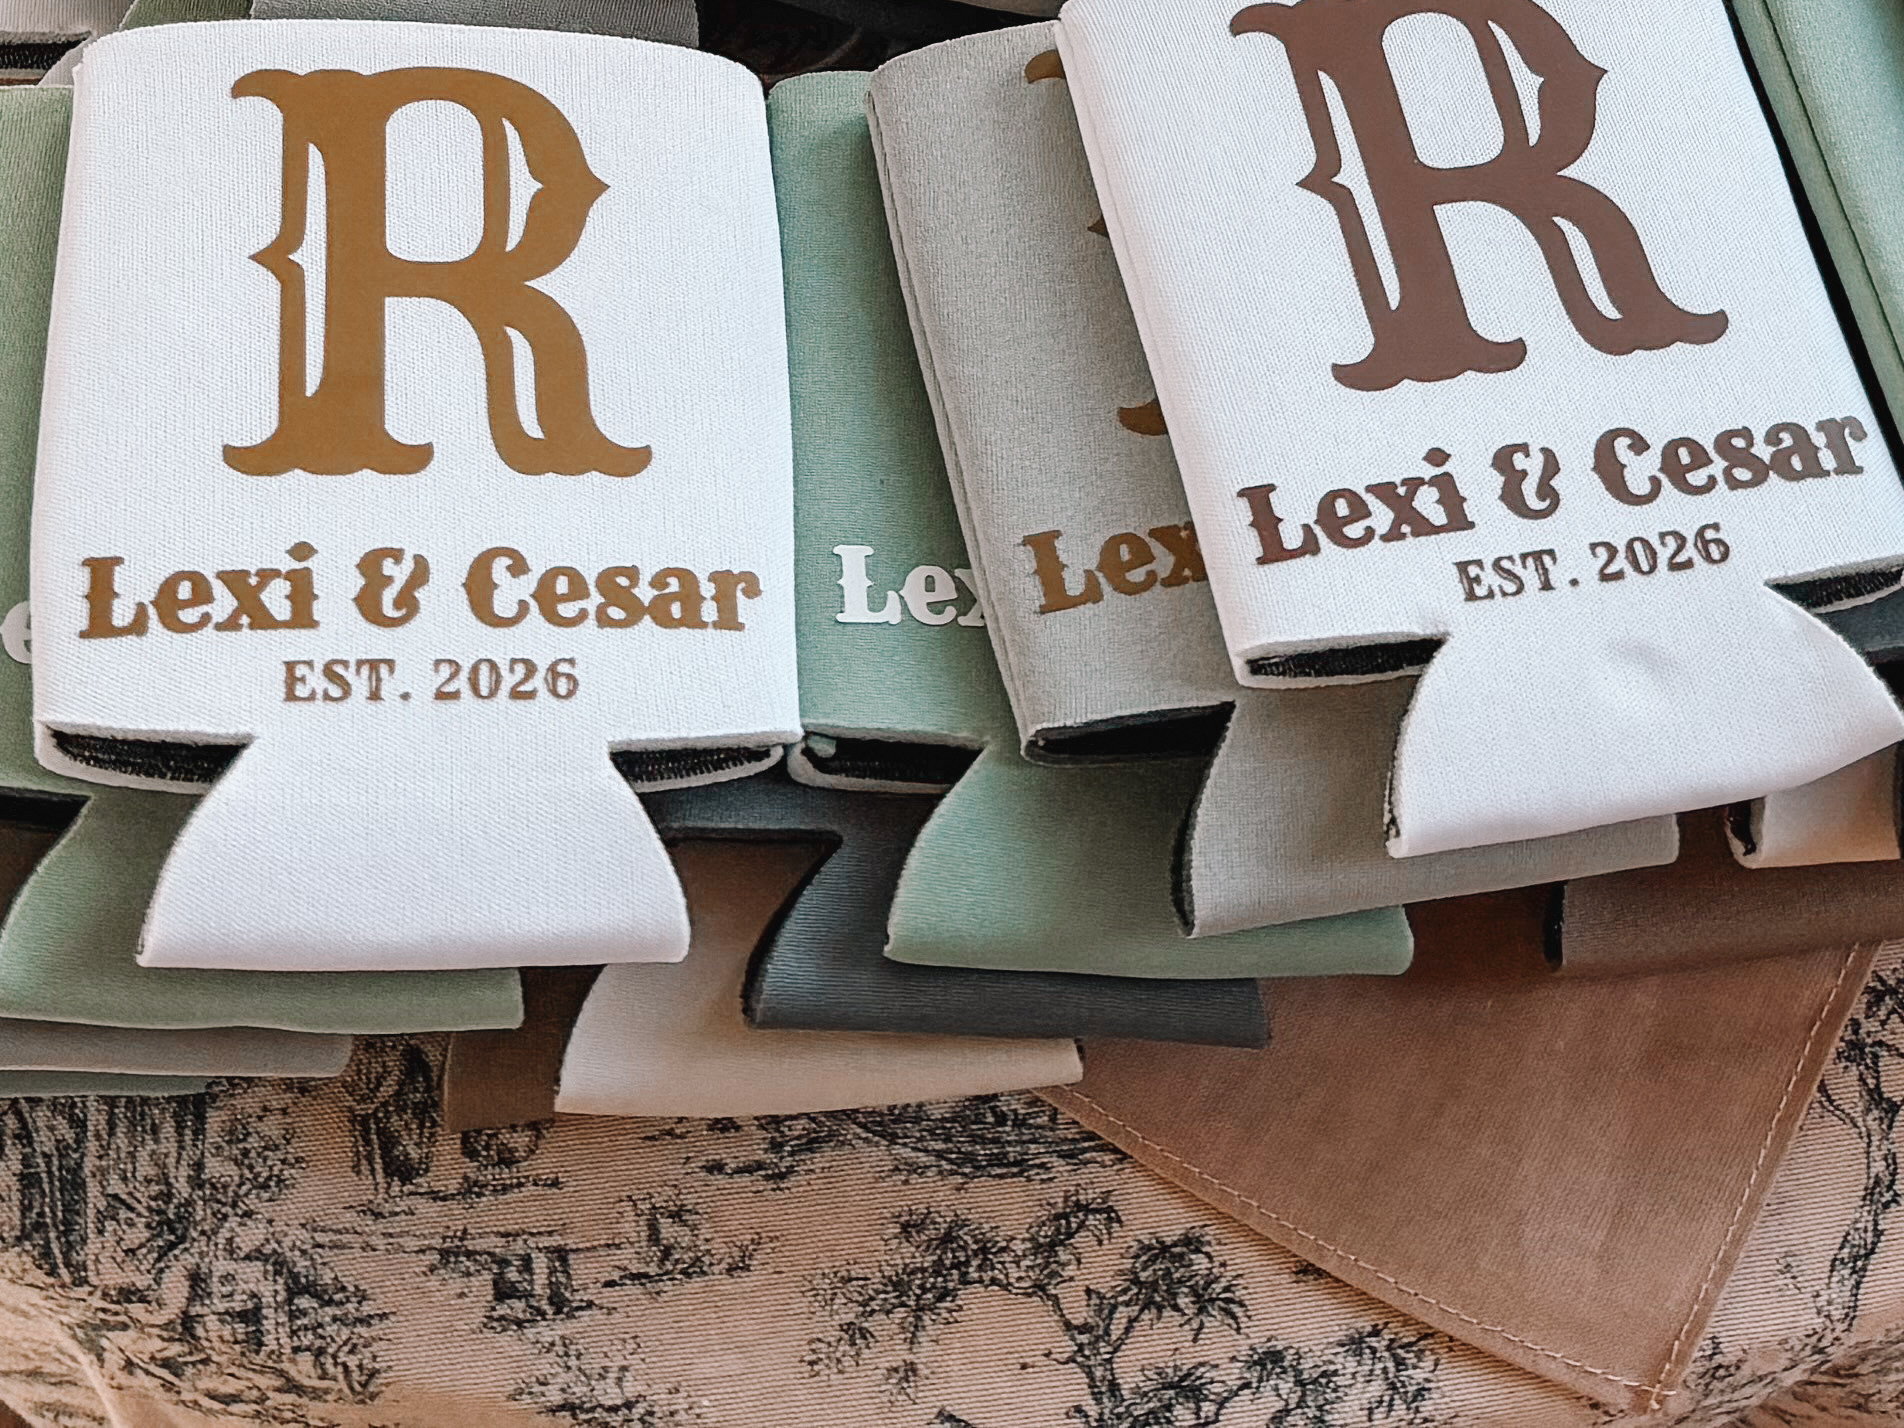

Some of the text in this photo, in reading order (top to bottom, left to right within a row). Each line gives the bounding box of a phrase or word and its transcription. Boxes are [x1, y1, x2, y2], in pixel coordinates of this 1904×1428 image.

[222, 66, 654, 479] R
[1237, 414, 1870, 566] Lexi & Cesar
[78, 541, 762, 640] Lexi & Cesar
[1452, 522, 1731, 604] EST. 2026
[282, 656, 581, 705] EST. 2026
